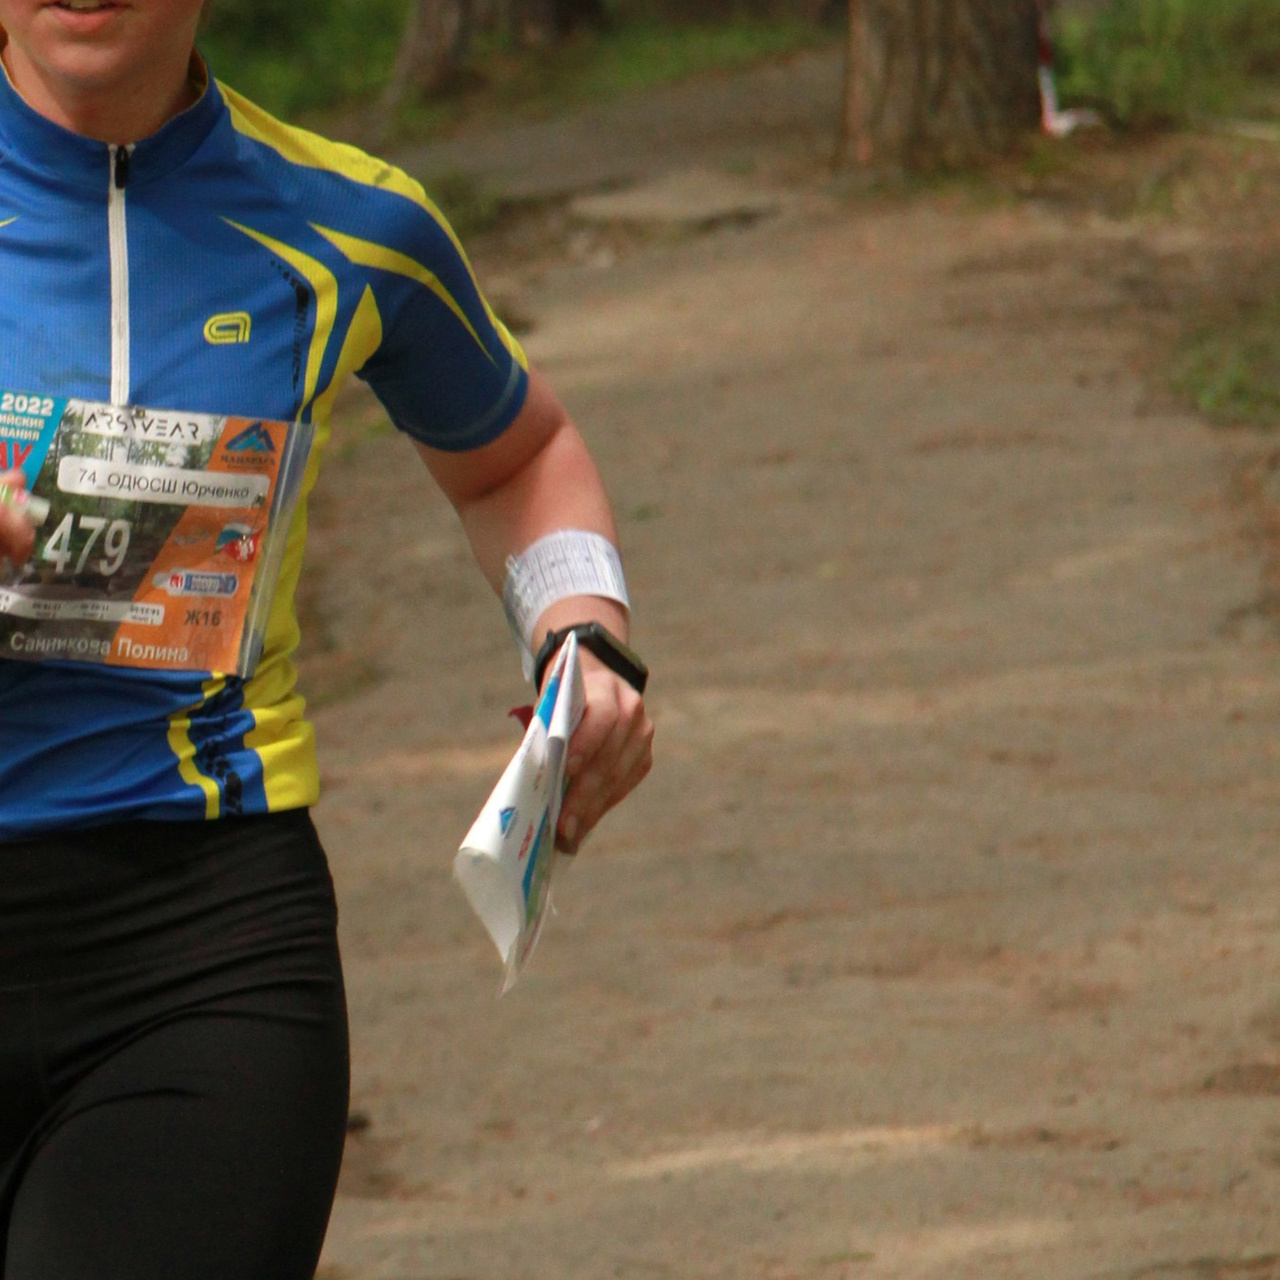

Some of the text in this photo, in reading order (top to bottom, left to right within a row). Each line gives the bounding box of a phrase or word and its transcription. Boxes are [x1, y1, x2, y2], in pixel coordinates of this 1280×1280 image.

[1, 393, 54, 416] 2022
[78, 468, 250, 499] 74_ОДЮСШ Юрченко
[43, 513, 131, 576] 479
[184, 609, 222, 626] Ж16
[10, 631, 189, 662] Санникова Полина
